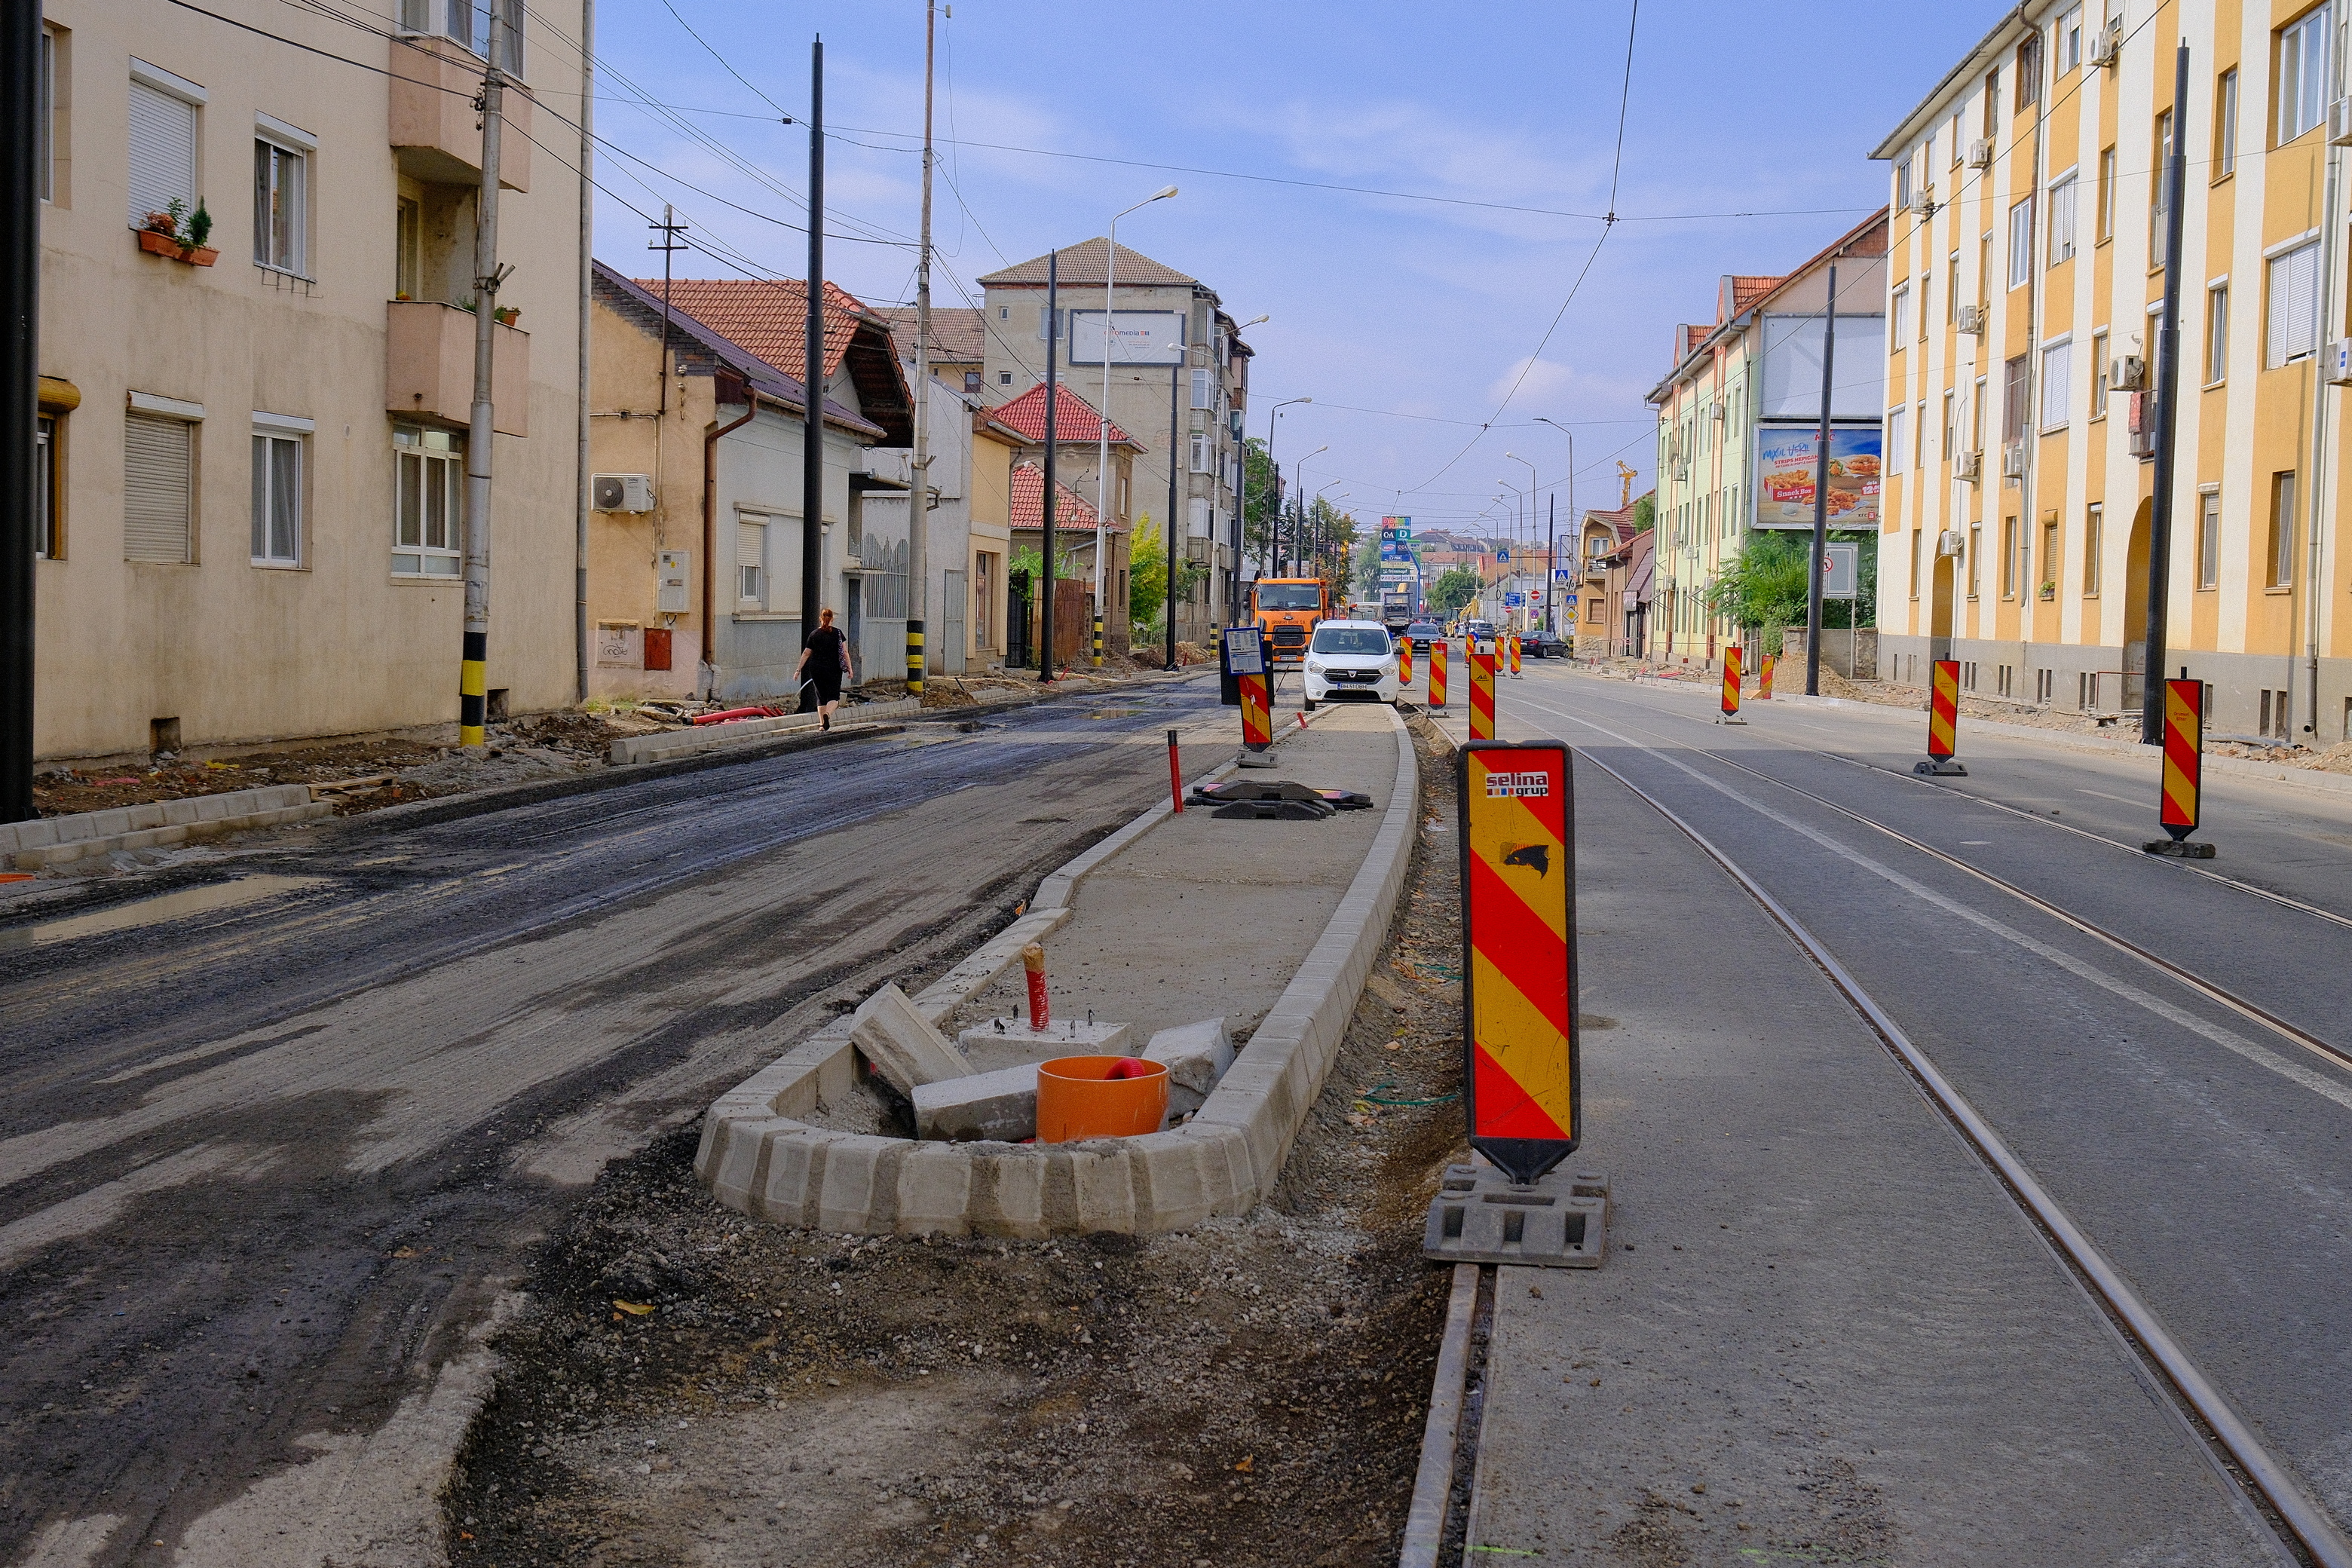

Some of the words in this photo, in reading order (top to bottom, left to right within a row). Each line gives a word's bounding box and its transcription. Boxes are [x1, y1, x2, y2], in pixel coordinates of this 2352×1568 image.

[1777, 489, 1799, 498] Snack
[1862, 485, 1873, 495] 12
[1486, 772, 1548, 787] selina
[1515, 787, 1548, 796] grup
